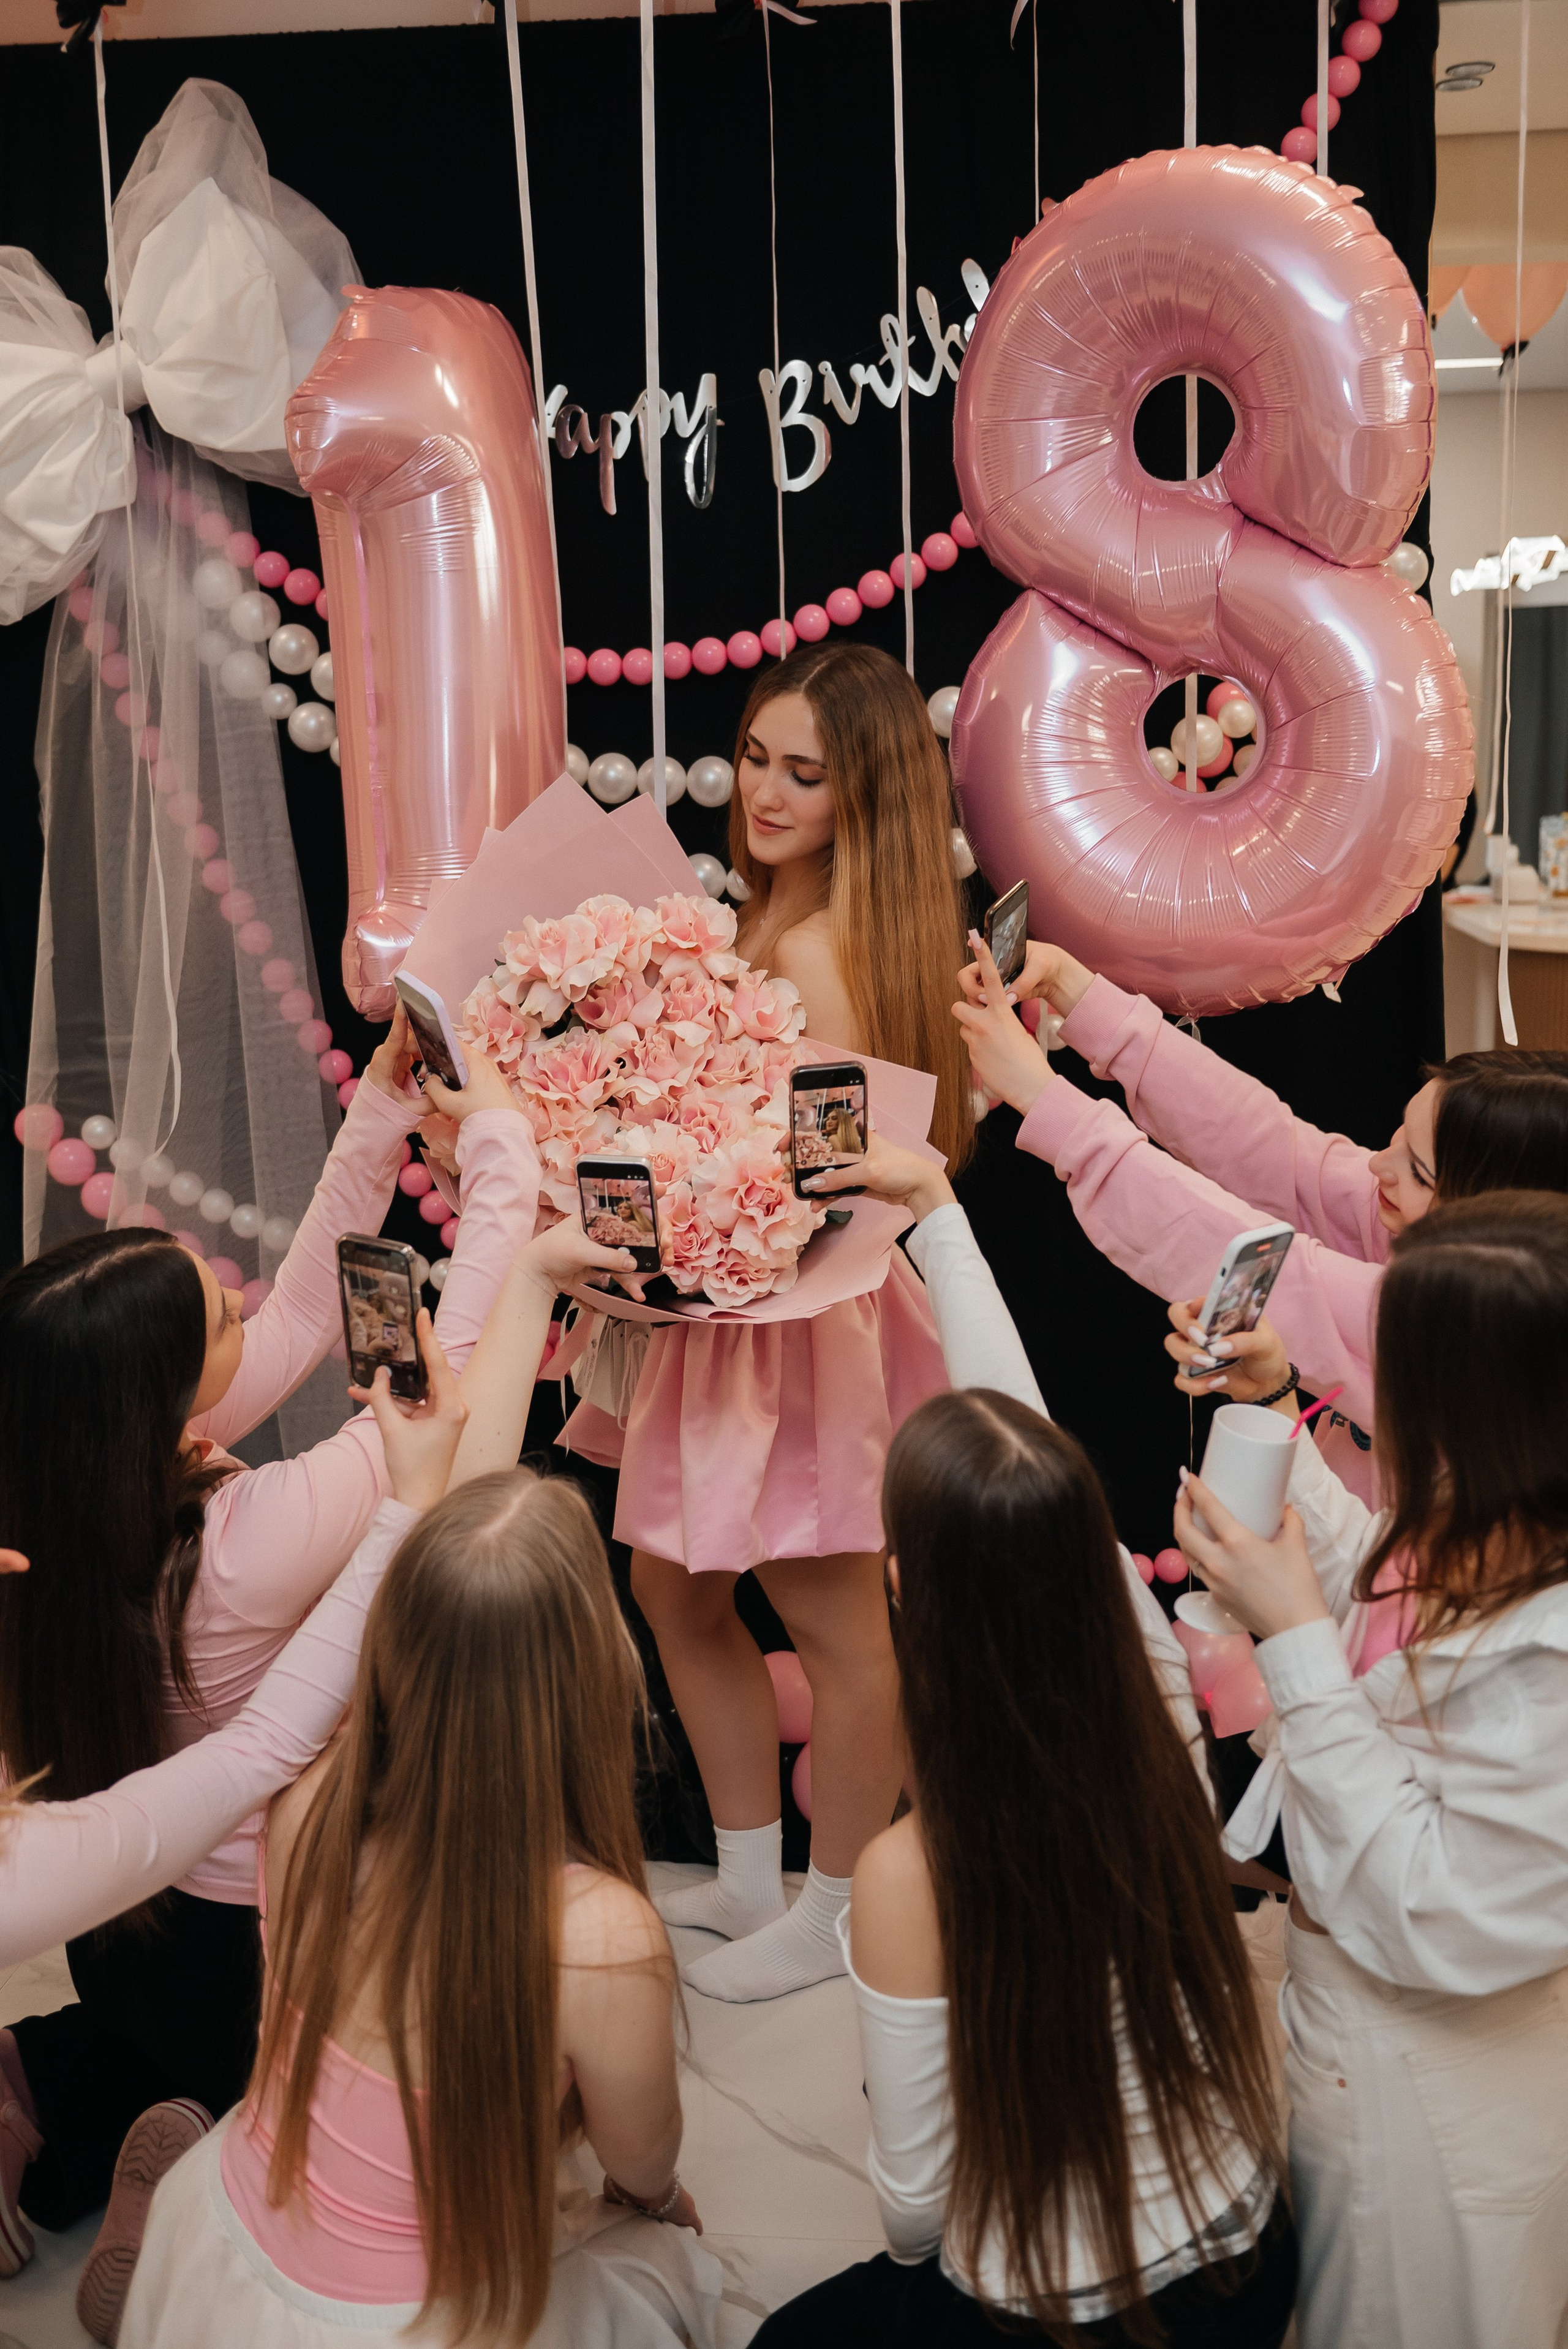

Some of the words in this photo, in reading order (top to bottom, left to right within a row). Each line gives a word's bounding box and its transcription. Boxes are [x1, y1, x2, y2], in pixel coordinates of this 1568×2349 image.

[284, 285, 568, 1022] 1
[952, 145, 1475, 1016] 8
[546, 373, 725, 515] appy
